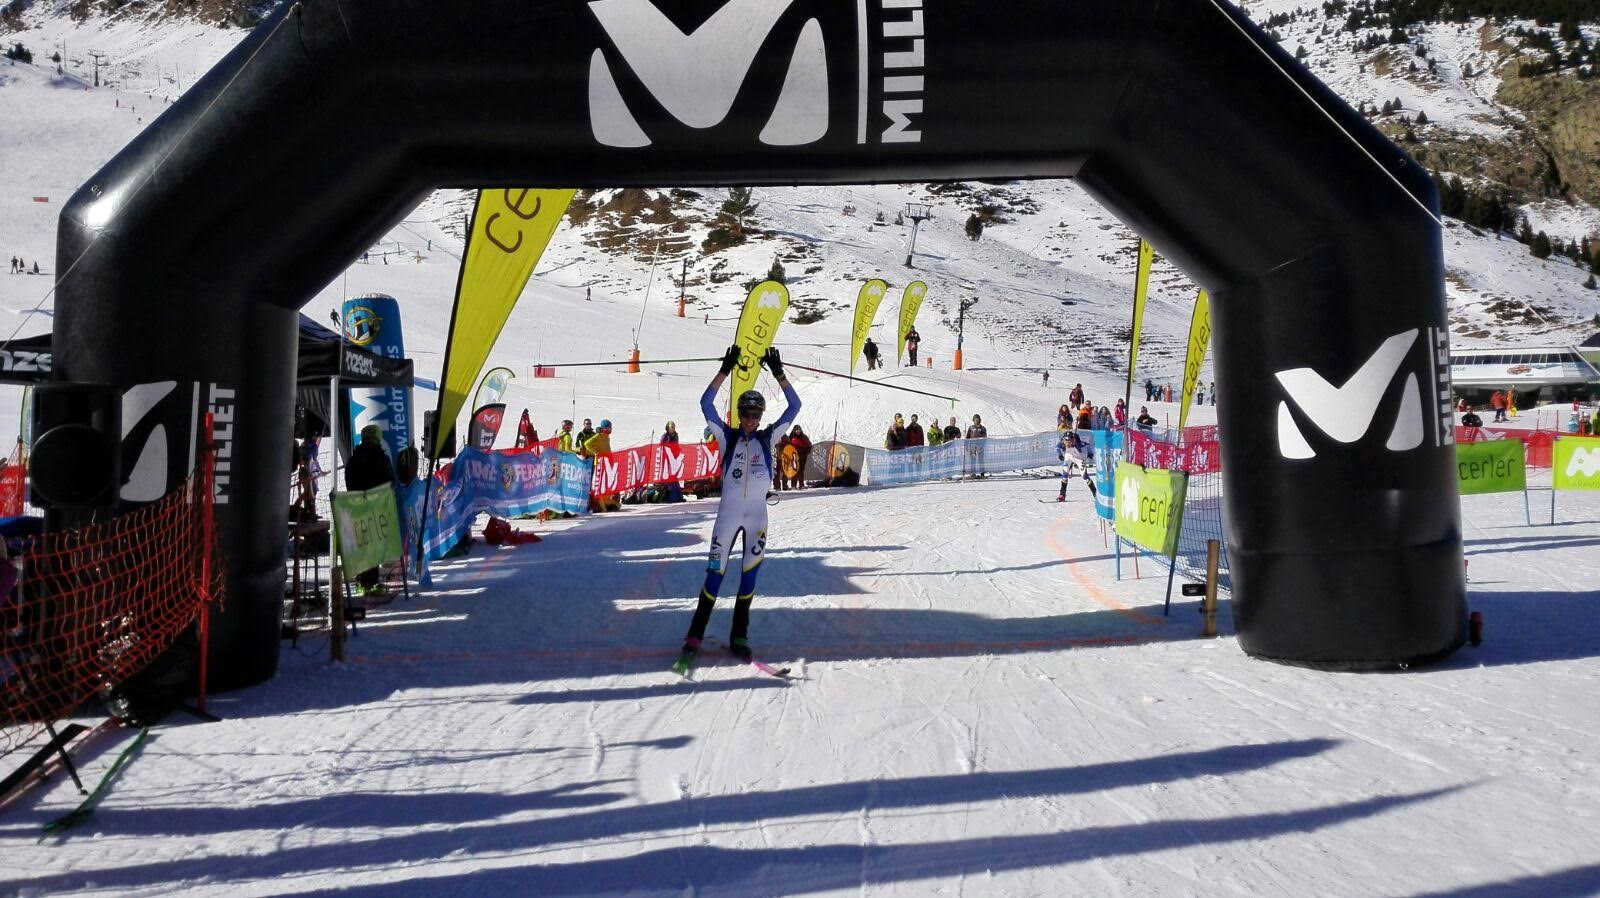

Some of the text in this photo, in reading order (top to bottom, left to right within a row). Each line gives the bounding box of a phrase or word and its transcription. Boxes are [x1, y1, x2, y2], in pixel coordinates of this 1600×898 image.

[735, 312, 771, 382] cerler
[854, 297, 876, 341] cerler
[901, 297, 918, 334] cerler
[1184, 311, 1212, 397] cerler
[1436, 326, 1455, 446] MILLET
[208, 382, 236, 504] MILLET
[1458, 455, 1516, 481] cerler
